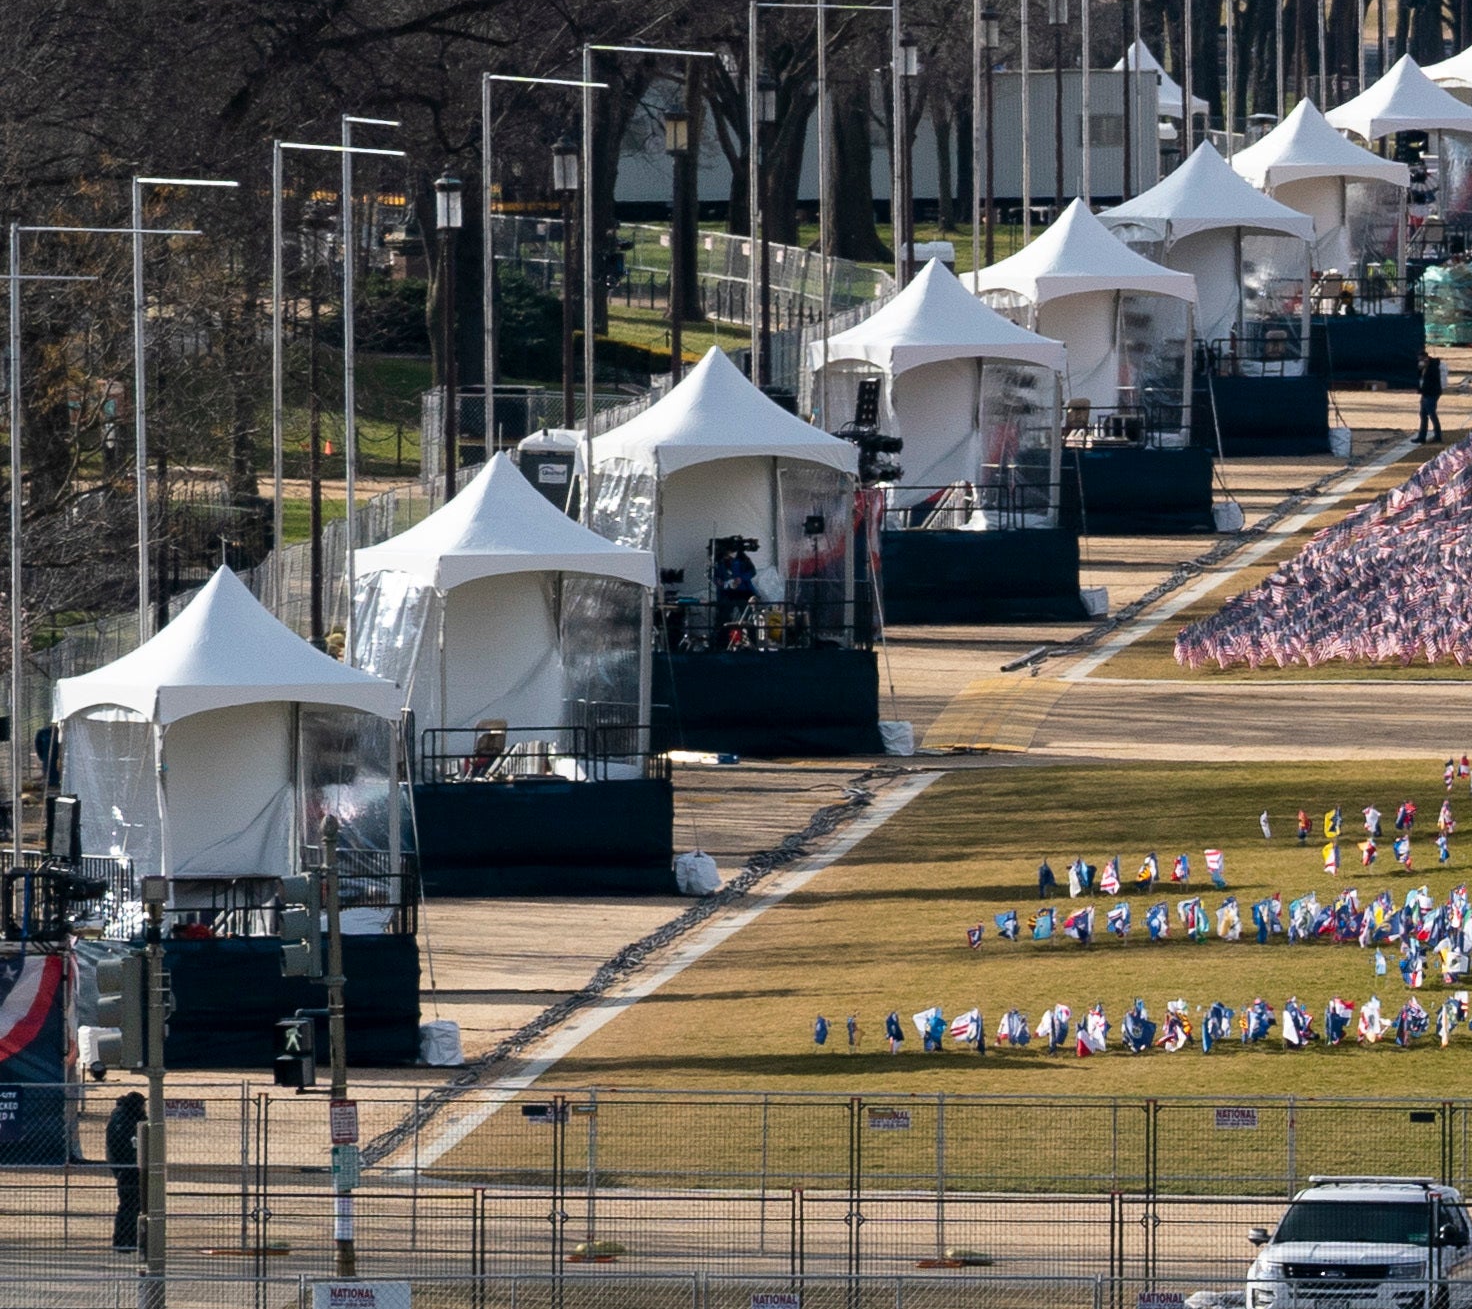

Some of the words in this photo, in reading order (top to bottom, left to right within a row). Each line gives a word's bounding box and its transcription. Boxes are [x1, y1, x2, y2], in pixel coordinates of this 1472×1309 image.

[1216, 1110, 1257, 1119] NATIONAL
[331, 1288, 375, 1299] NATIONAL
[1139, 1293, 1184, 1303] NATIONAL
[752, 1295, 798, 1304] NATIONAL
